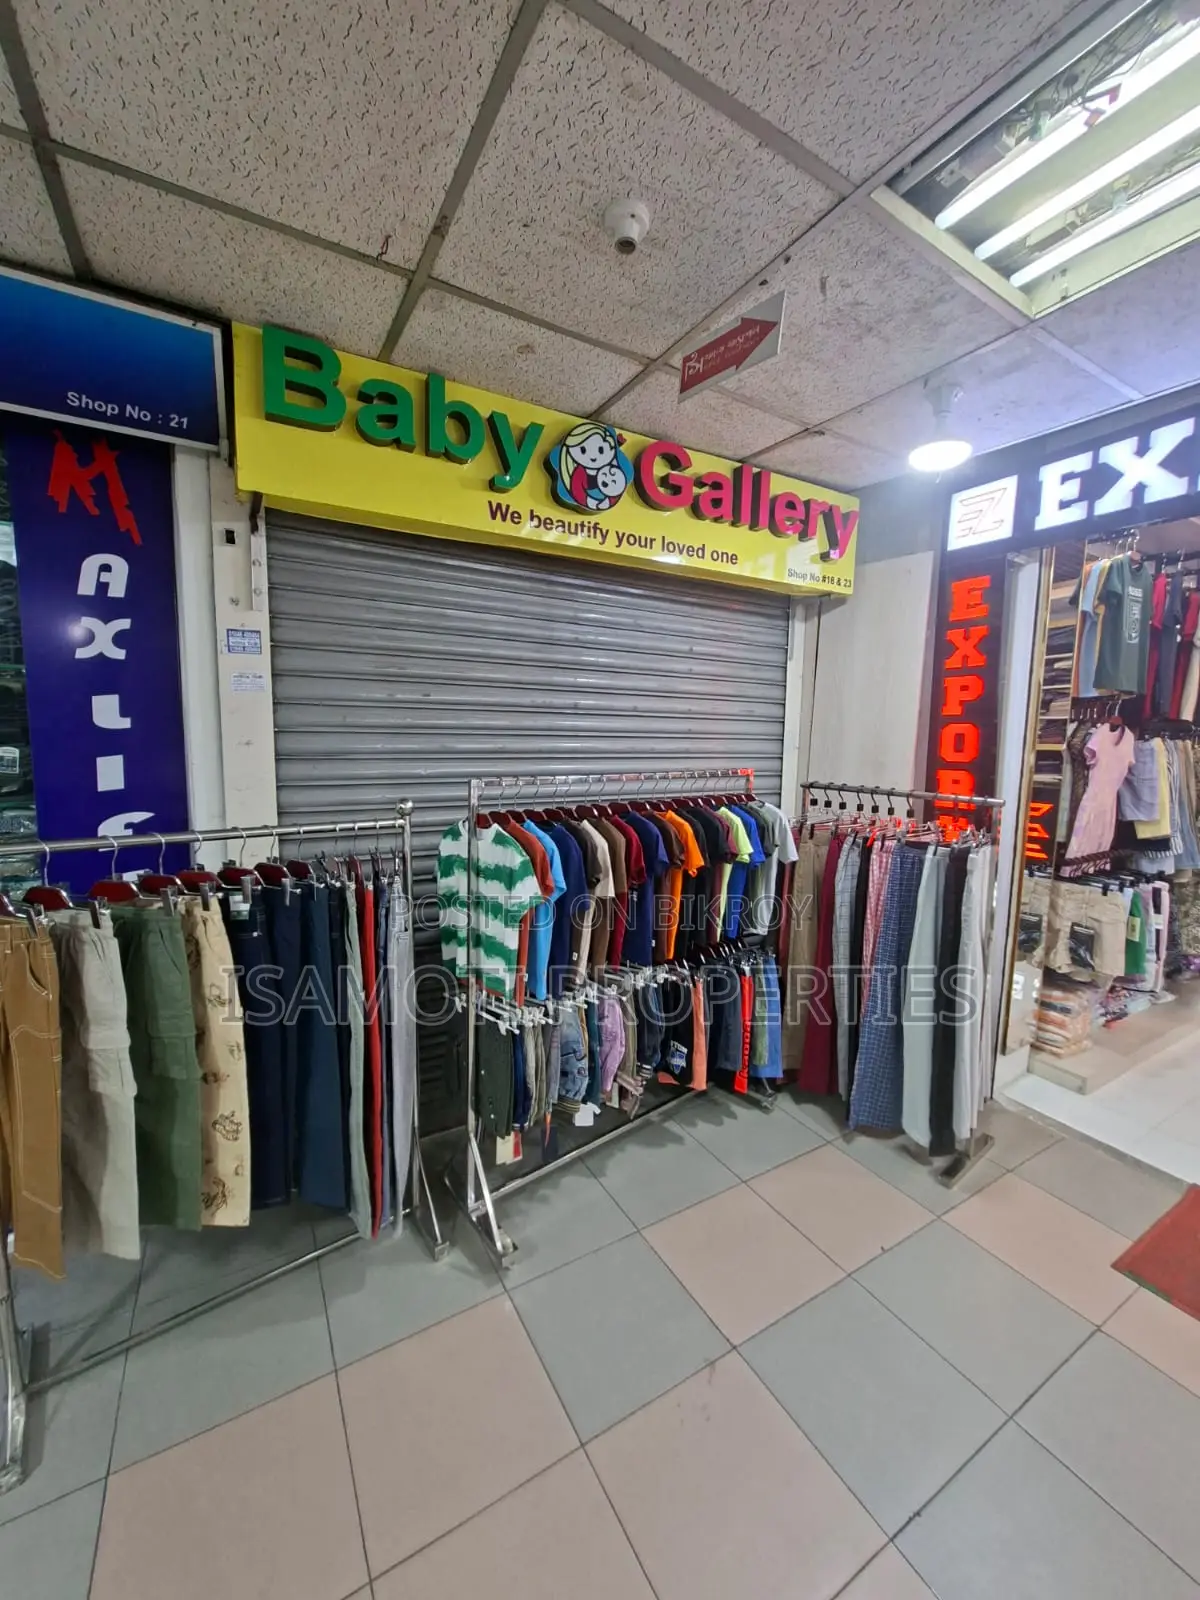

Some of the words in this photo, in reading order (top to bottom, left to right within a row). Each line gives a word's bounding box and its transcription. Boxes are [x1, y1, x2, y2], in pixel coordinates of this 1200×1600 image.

[66, 391, 119, 416] Shop
[125, 404, 151, 422] No
[169, 414, 189, 429] 21
[261, 323, 546, 493] Baby
[634, 440, 859, 562] Gallery
[1034, 417, 1200, 531] EX
[488, 500, 522, 525] We
[529, 509, 609, 545] beautify
[615, 530, 656, 548] your
[661, 535, 706, 559] loved
[710, 549, 738, 565] one
[788, 568, 808, 583] Shop
[809, 572, 820, 583] No
[843, 579, 852, 587] 23
